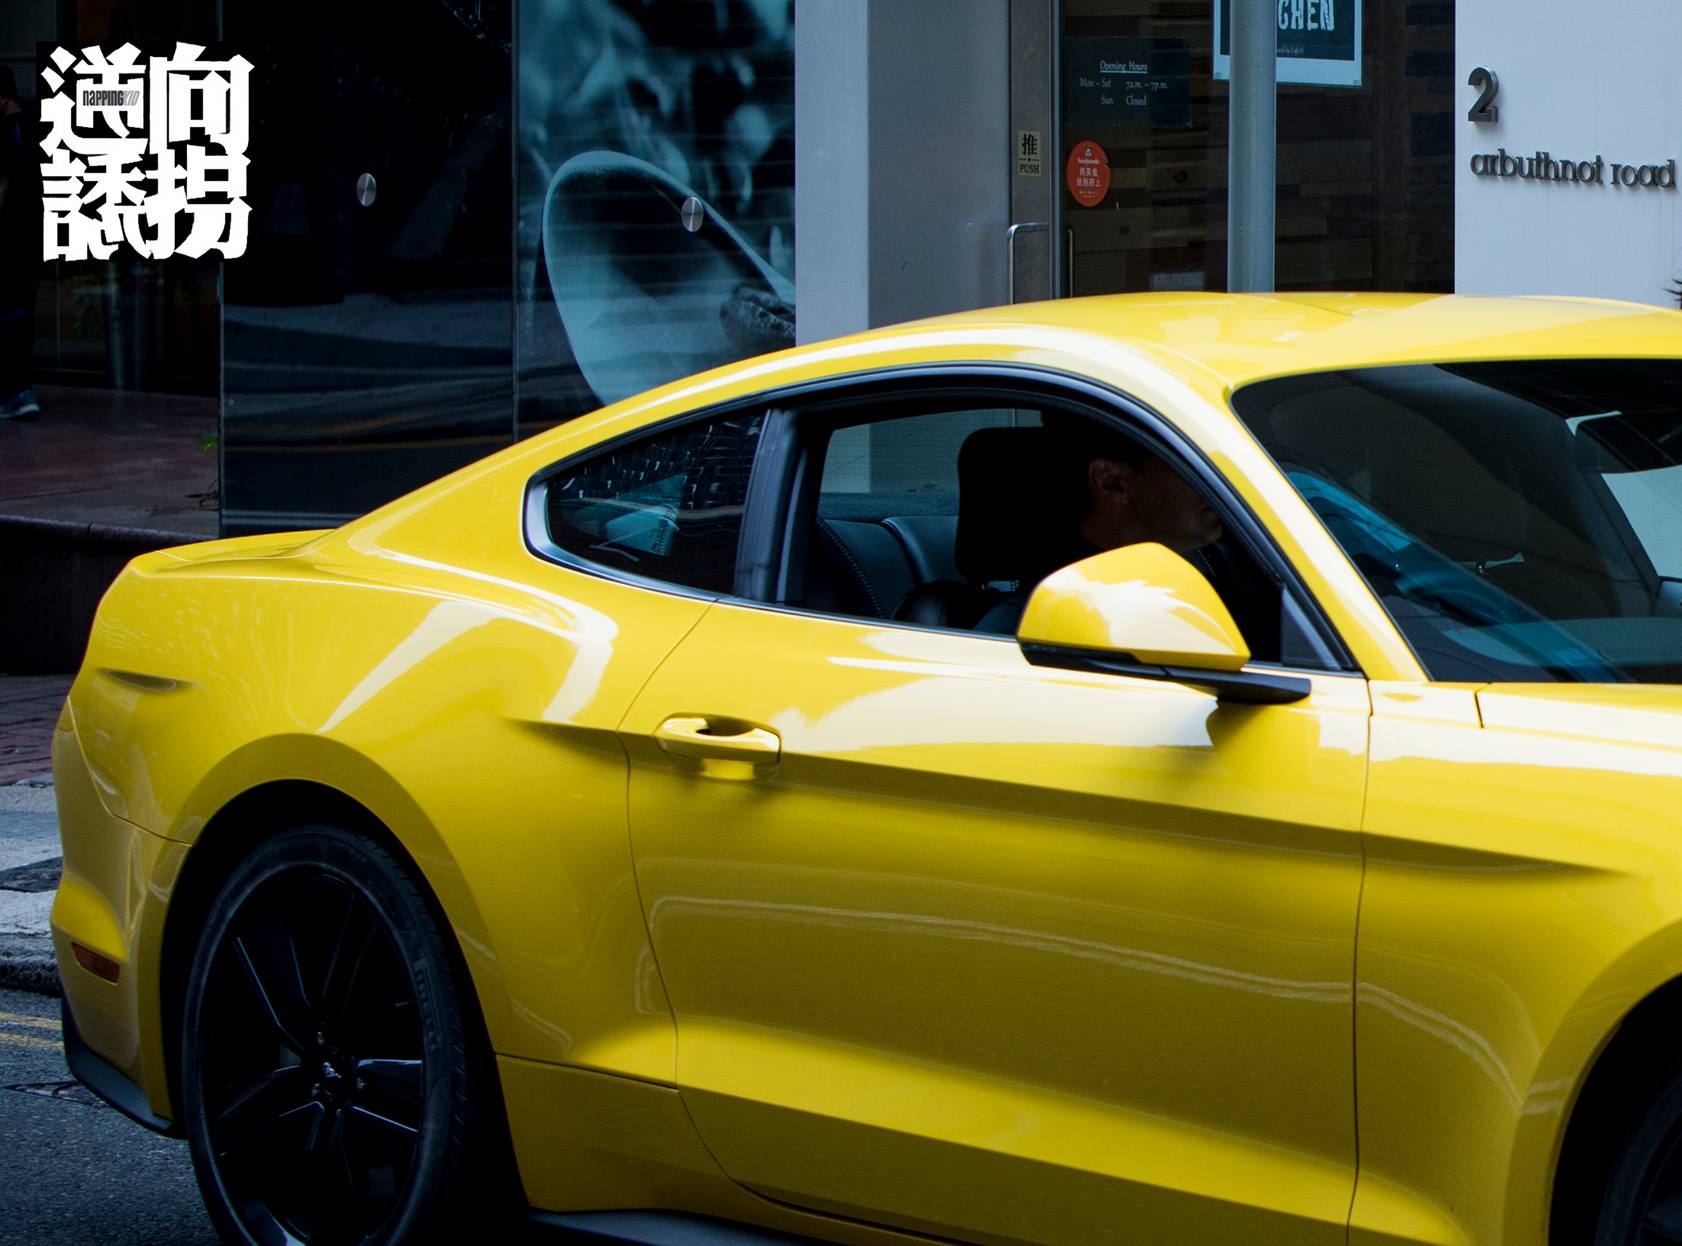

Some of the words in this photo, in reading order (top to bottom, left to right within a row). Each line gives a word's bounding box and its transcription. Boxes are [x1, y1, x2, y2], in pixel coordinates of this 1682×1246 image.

[1277, 0, 1335, 31] CHEN
[1100, 60, 1126, 74] Opening
[1128, 61, 1148, 73] Hours
[1126, 95, 1147, 106] Closed
[1468, 67, 1498, 123] 2
[1022, 133, 1038, 156] 推
[1019, 163, 1040, 174] PUSH
[1470, 148, 1604, 184] arbuthnot
[1610, 159, 1677, 189] road
